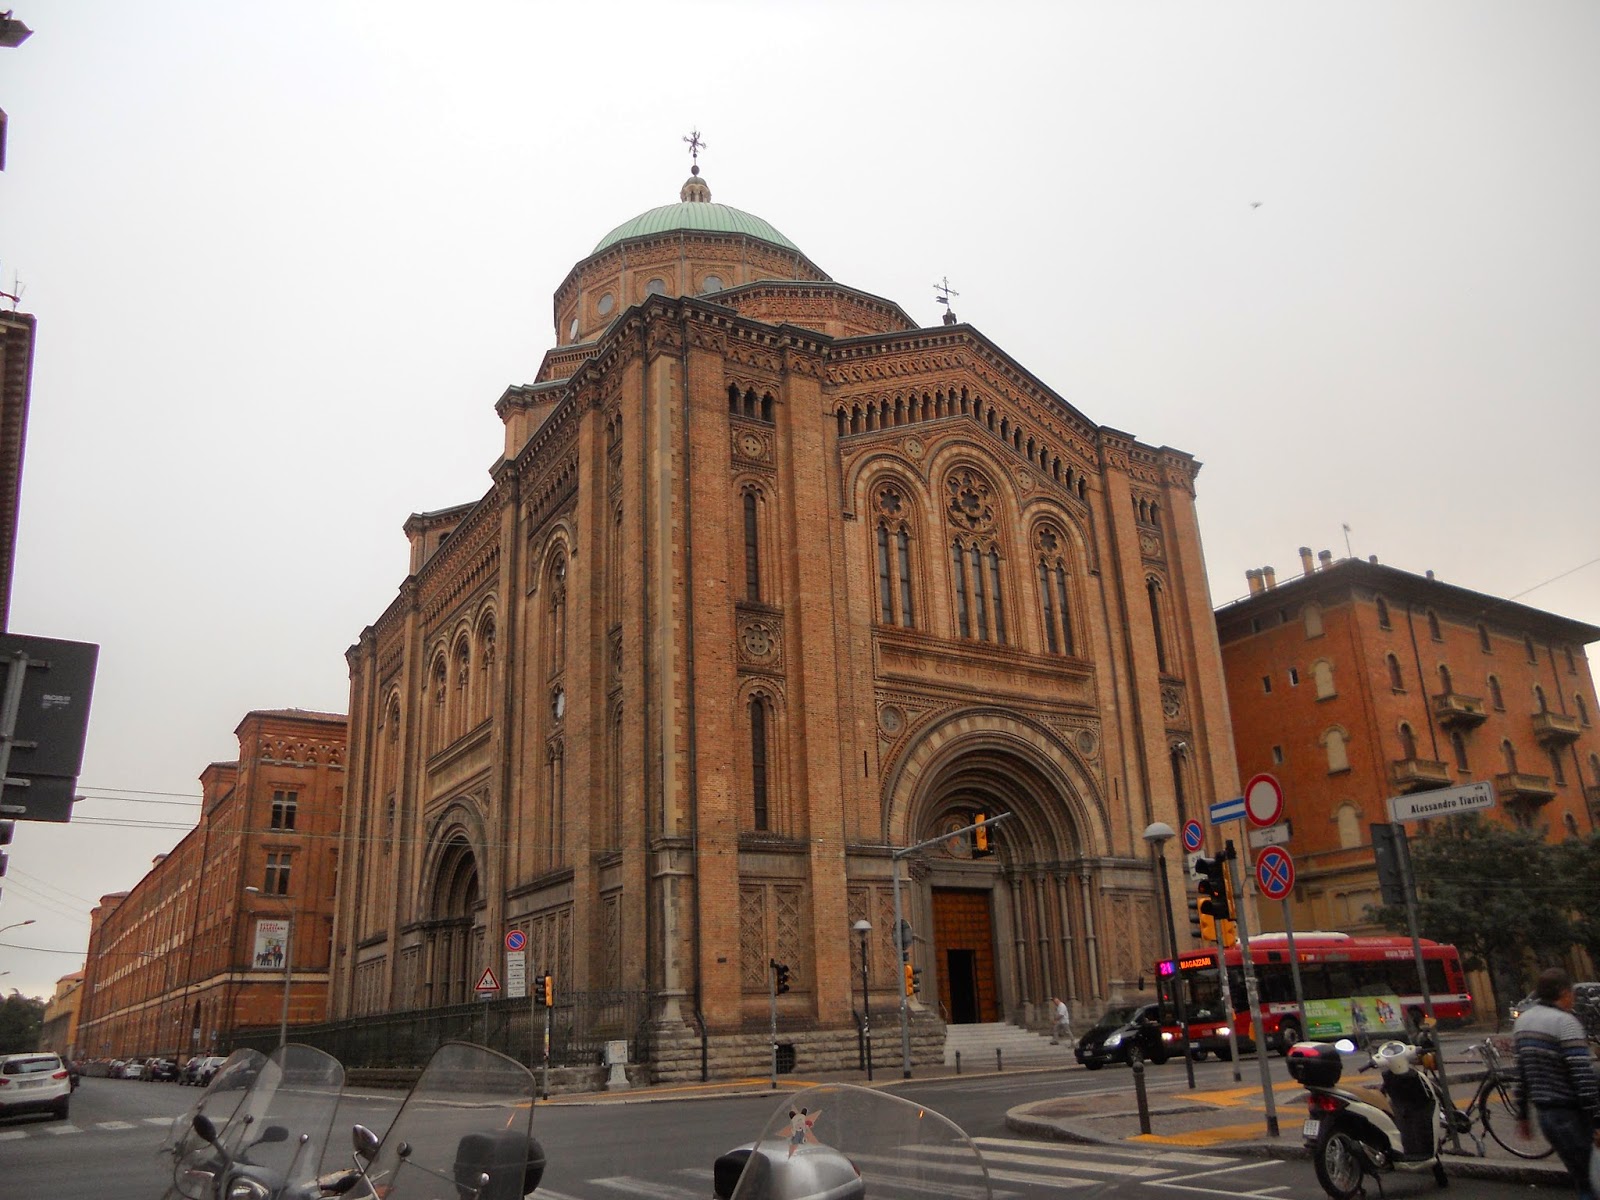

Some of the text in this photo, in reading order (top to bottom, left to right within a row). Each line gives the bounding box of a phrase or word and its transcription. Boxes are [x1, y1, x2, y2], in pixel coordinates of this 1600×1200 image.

[935, 663, 971, 678] CORDI
[976, 669, 1001, 683] IESV
[1410, 792, 1488, 814] Alessandro Tiarini
